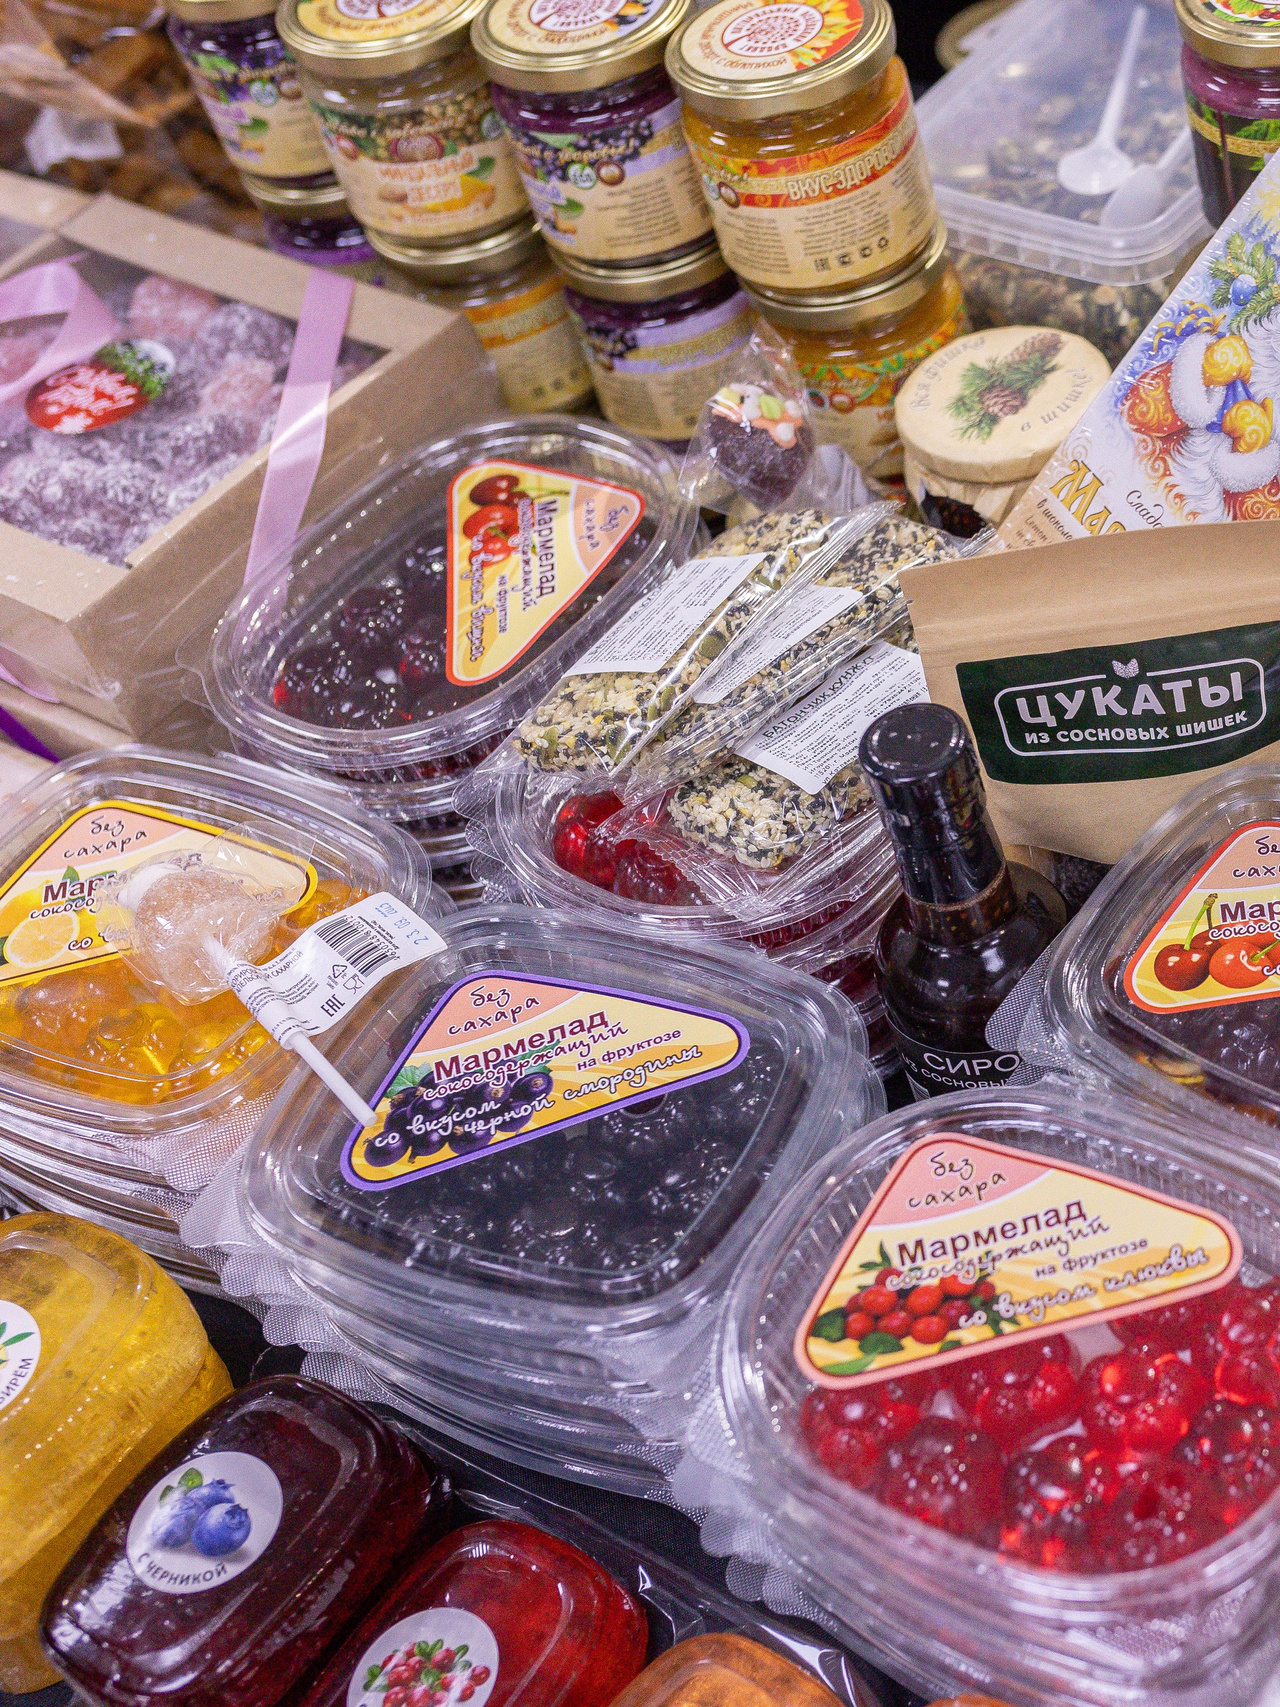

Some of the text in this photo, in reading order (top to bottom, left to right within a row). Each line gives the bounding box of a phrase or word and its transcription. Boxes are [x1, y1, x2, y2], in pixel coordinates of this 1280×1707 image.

[579, 499, 600, 552] сахара
[600, 504, 629, 532] без
[538, 499, 559, 598] Мармелад
[461, 552, 494, 605] вкусом
[498, 574, 509, 635] на фруктозе
[762, 692, 829, 738] БАТОНЧИК
[1016, 671, 1243, 728] ЦУКАТЫ
[63, 828, 149, 860] сахара
[87, 815, 126, 837] без
[447, 995, 541, 1036] сахара
[469, 983, 511, 1009] без
[422, 1022, 630, 1101] сокосодержащий
[433, 1009, 610, 1082] Мармелад
[576, 1028, 682, 1072] на фруктозе
[922, 1051, 1020, 1077] СИРО
[374, 1044, 702, 1149] со вкусом черной смородины
[920, 1067, 1010, 1090] СОСНОВЫ
[929, 1151, 977, 1180] без
[907, 1171, 1008, 1210] сахара
[886, 1216, 1112, 1291] сокосодержащий
[898, 1199, 1088, 1267] Мармелад
[1034, 1238, 1150, 1279] на фруктозе
[957, 1243, 1210, 1331] со вкусом клюквы
[138, 1552, 229, 1586] С ЧЕРНИКОЙ
